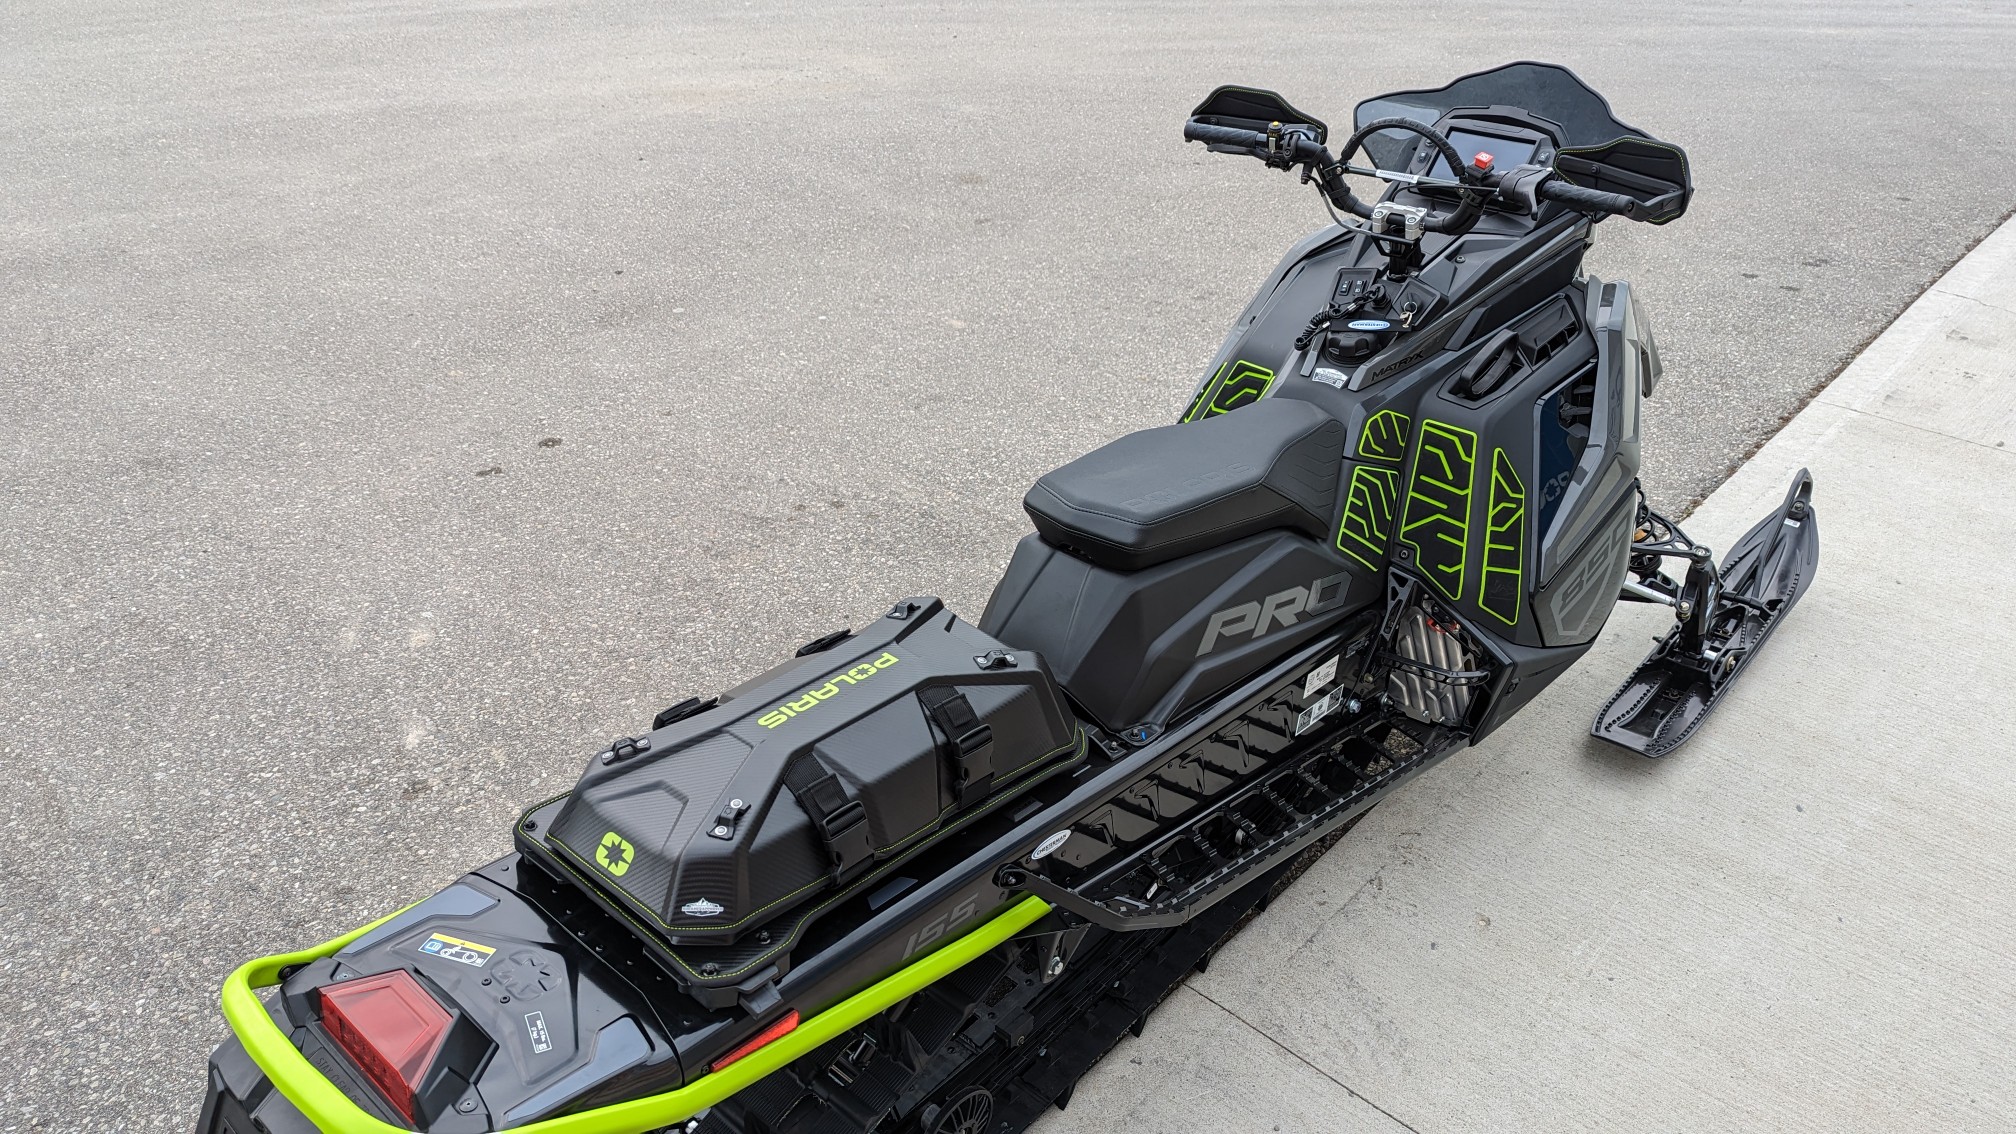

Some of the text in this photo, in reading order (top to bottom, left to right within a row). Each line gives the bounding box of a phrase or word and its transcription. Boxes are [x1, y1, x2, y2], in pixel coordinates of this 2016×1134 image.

[1371, 350, 1424, 382] MATRYX
[1559, 511, 1632, 614] 850
[1195, 571, 1354, 658] PRO
[756, 651, 899, 730] POLARIS
[901, 892, 979, 961] 155
[317, 1057, 334, 1074] STAY
